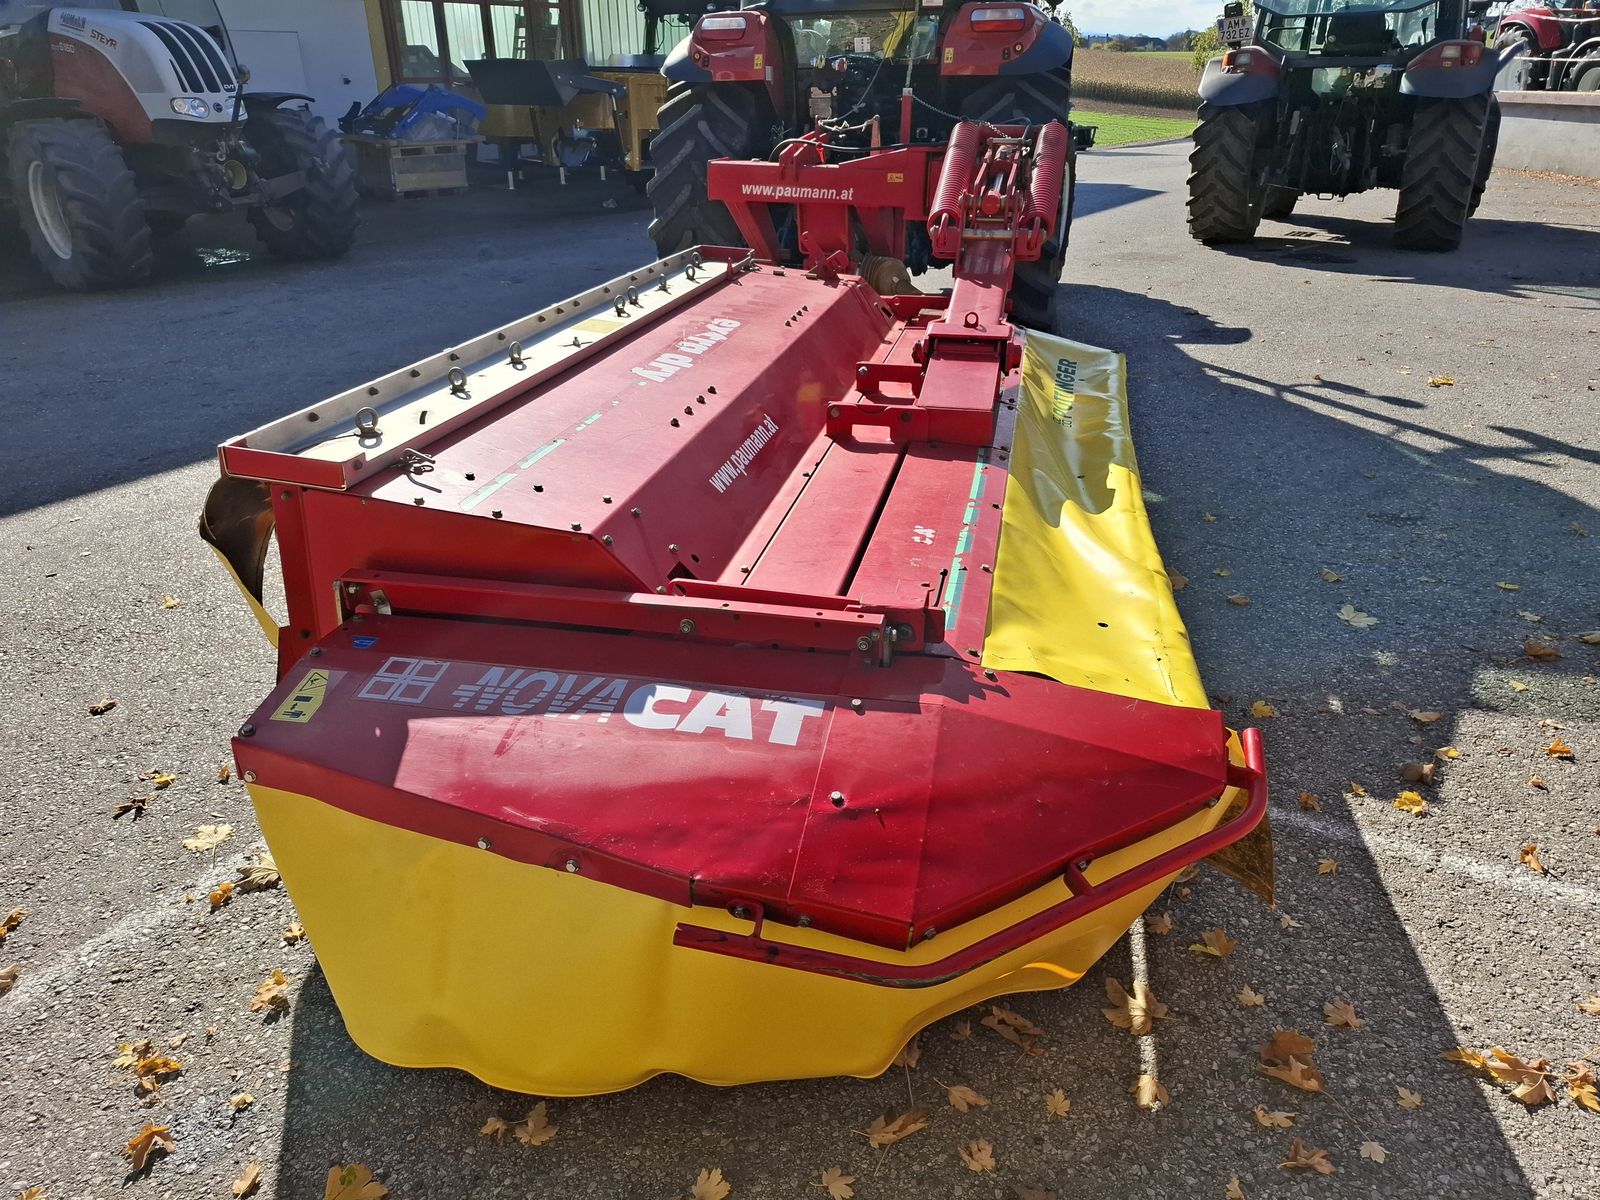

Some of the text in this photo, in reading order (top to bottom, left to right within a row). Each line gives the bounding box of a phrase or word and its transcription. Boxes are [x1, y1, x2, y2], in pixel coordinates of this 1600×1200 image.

[1227, 19, 1240, 30] AM
[90, 29, 118, 50] STEYR
[1220, 28, 1250, 40] 732 EZ
[741, 184, 855, 201] www.paumann.at
[708, 413, 780, 494] www.paumann.at
